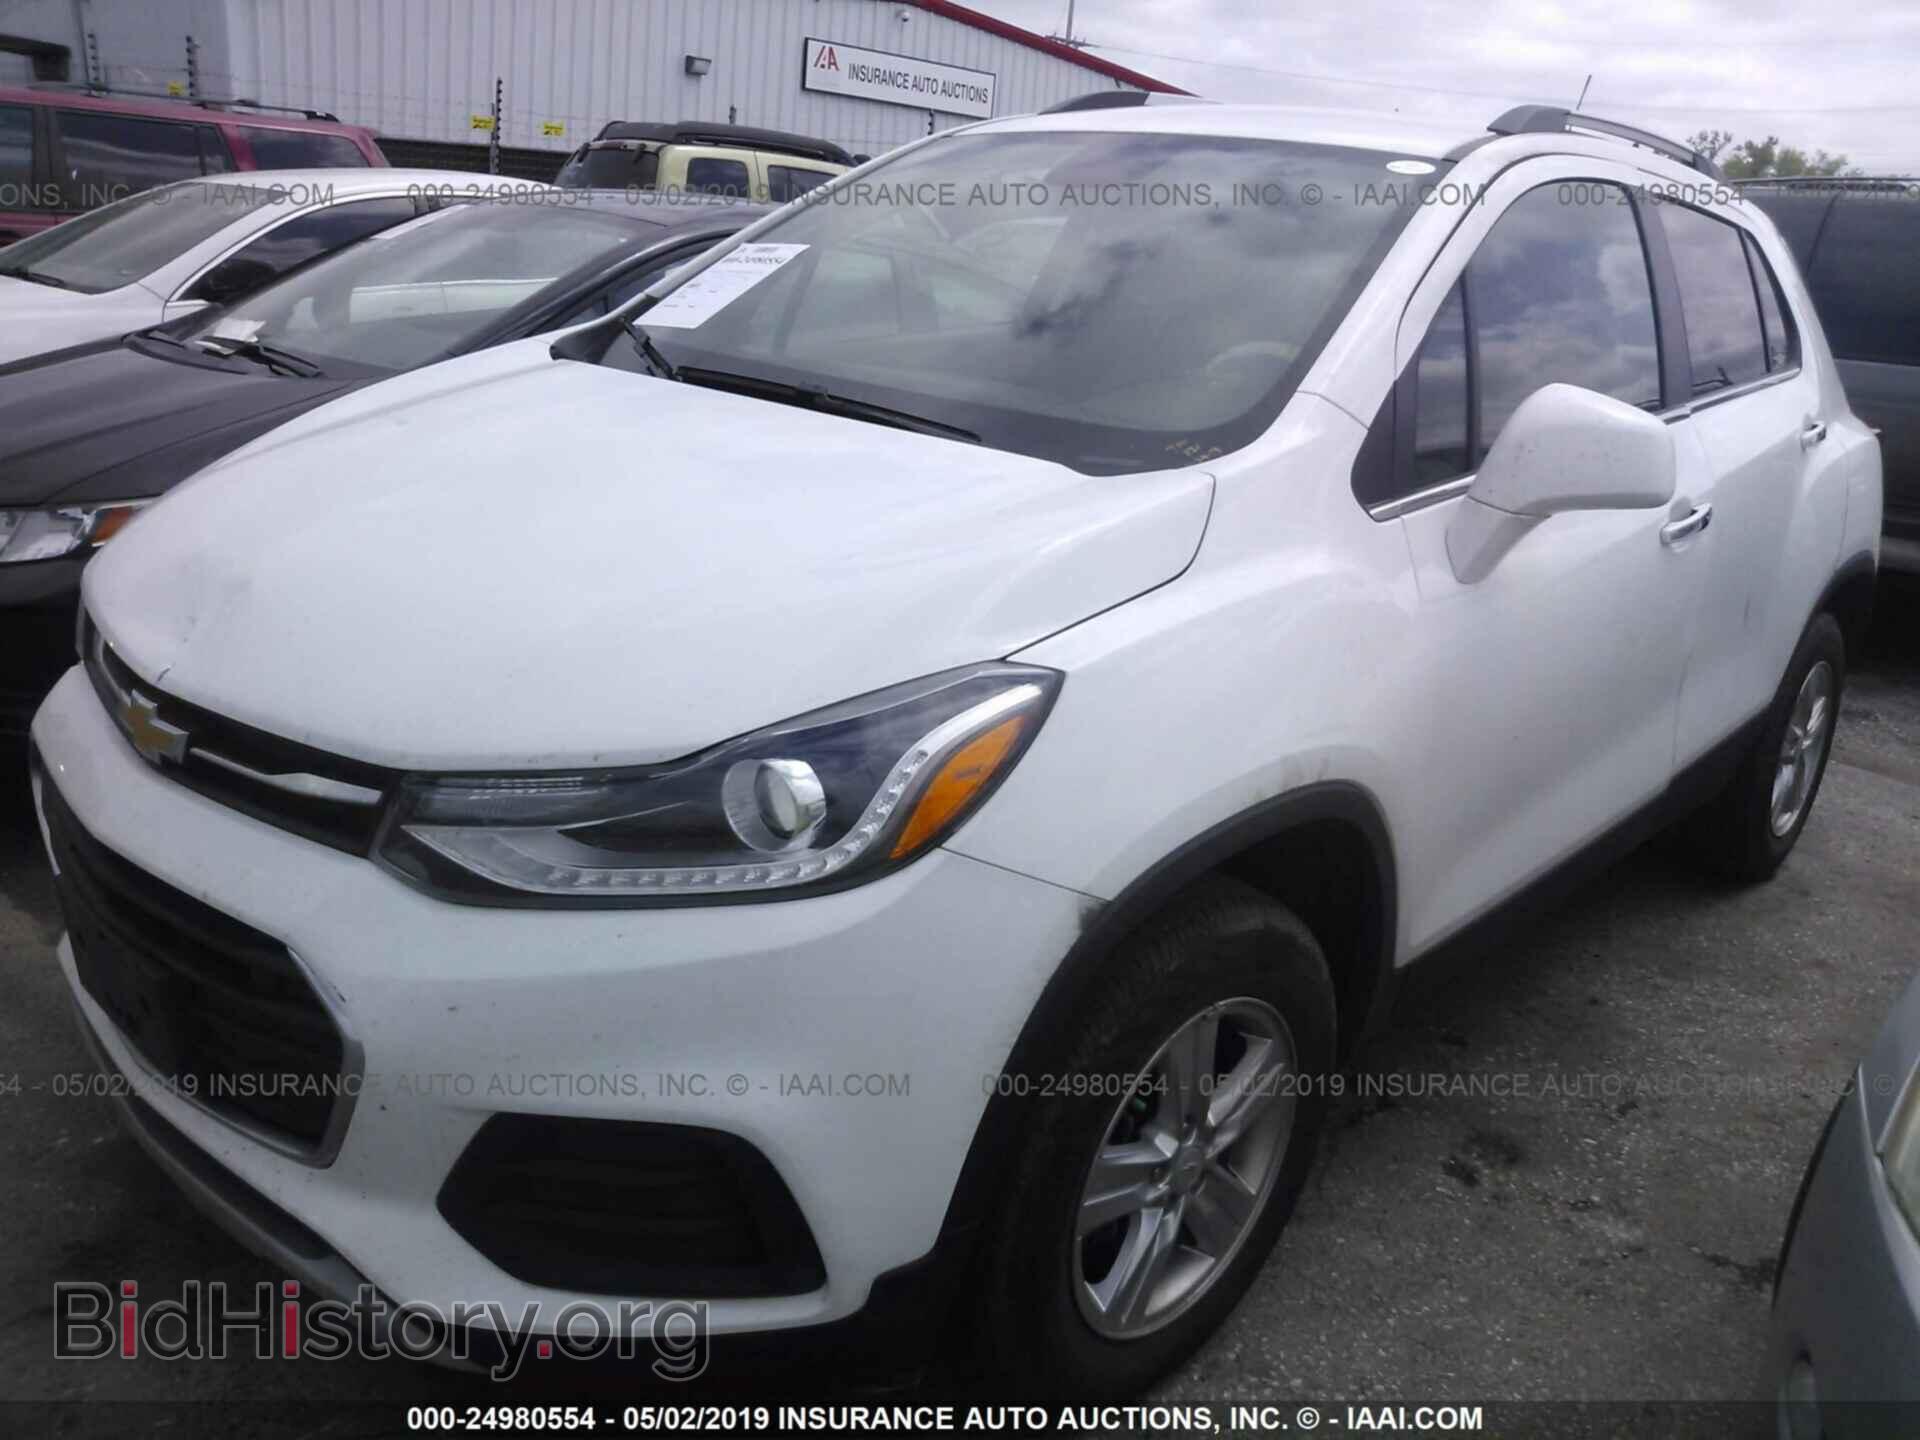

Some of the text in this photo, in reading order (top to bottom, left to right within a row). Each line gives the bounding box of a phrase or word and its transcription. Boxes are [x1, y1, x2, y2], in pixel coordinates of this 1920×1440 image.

[848, 63, 988, 104] INSURANCE AUTO AUCTIONS
